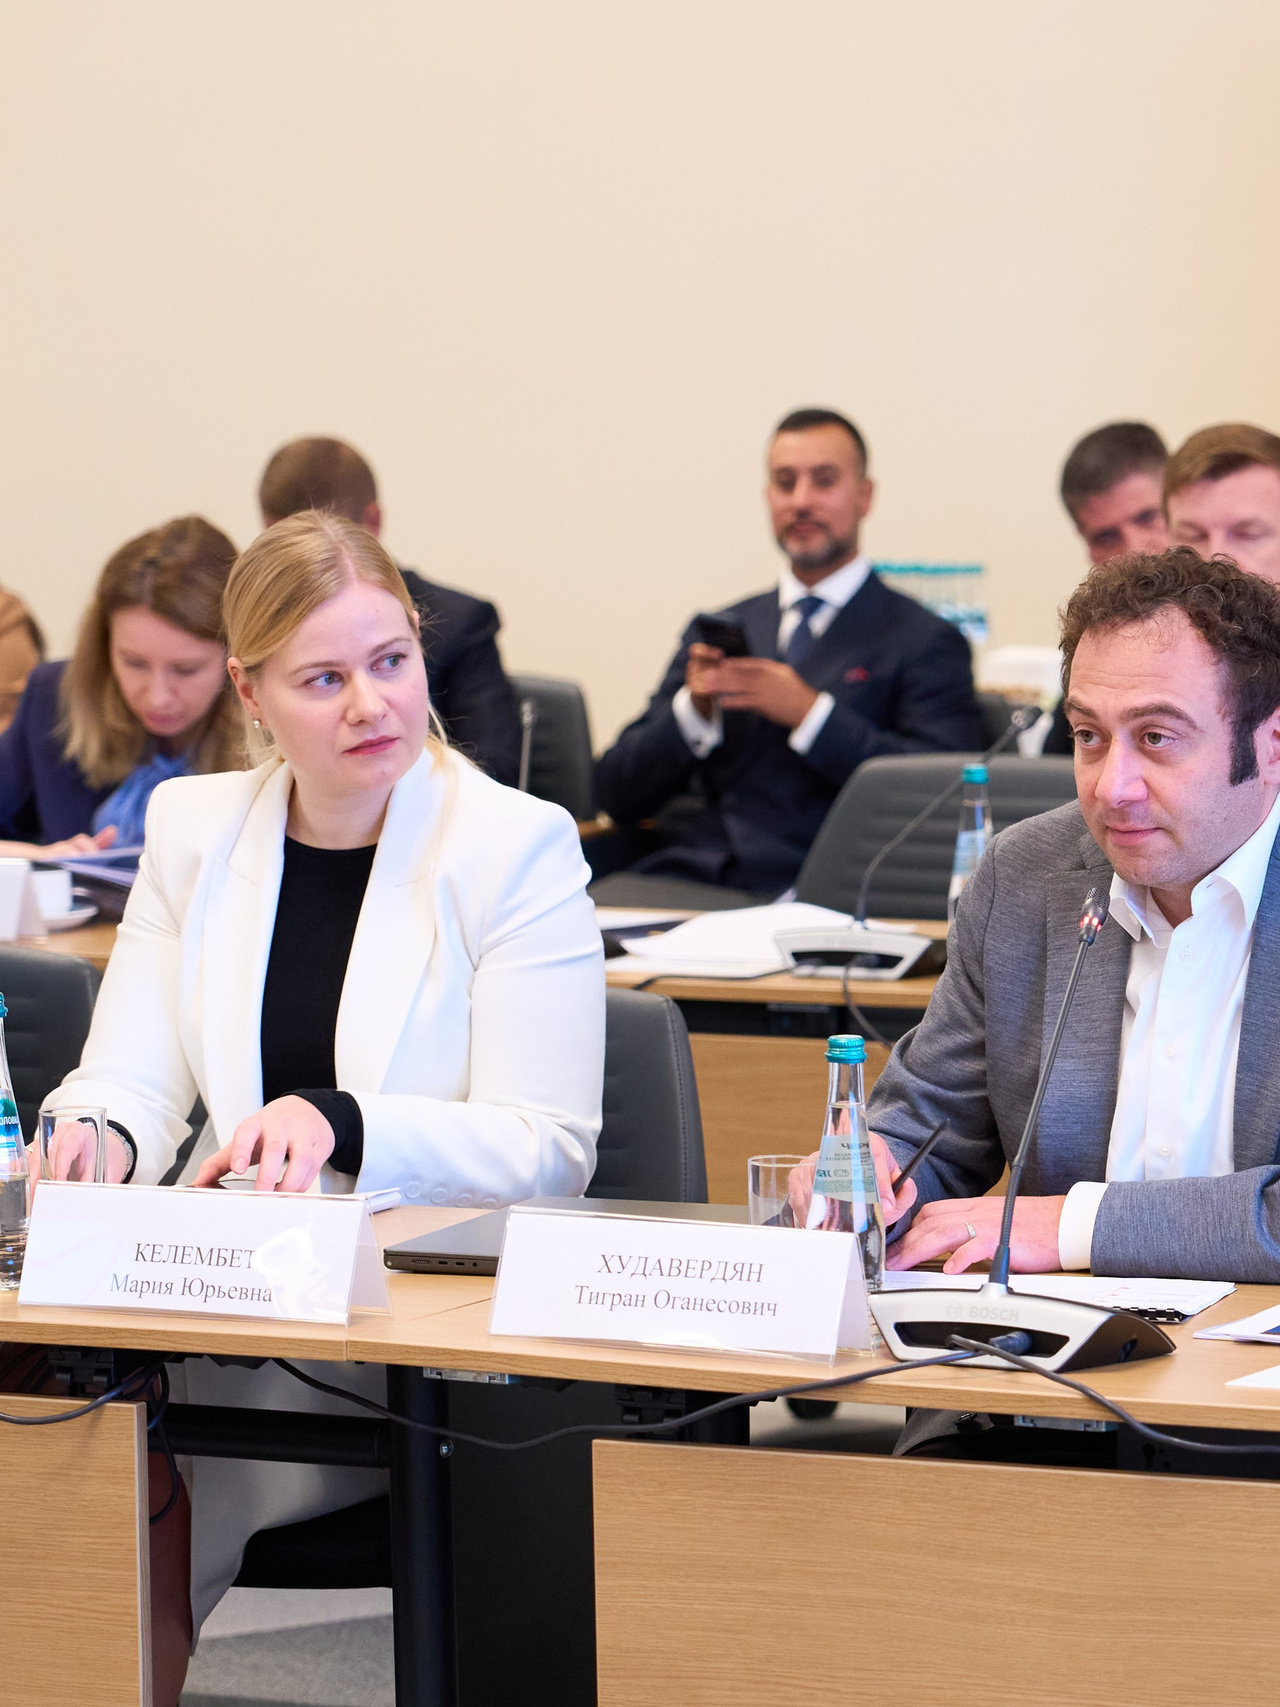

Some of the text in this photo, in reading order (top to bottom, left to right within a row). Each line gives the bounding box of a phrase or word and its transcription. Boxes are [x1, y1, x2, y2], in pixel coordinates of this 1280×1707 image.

[134, 1243, 257, 1269] КЕЛЕМБЕТ
[596, 1253, 766, 1284] ХУДАВЕРДЯН
[110, 1272, 273, 1303] Мария Юрьевна
[574, 1284, 779, 1317] Тигран Оганесович
[969, 1305, 1020, 1322] BOSCH
